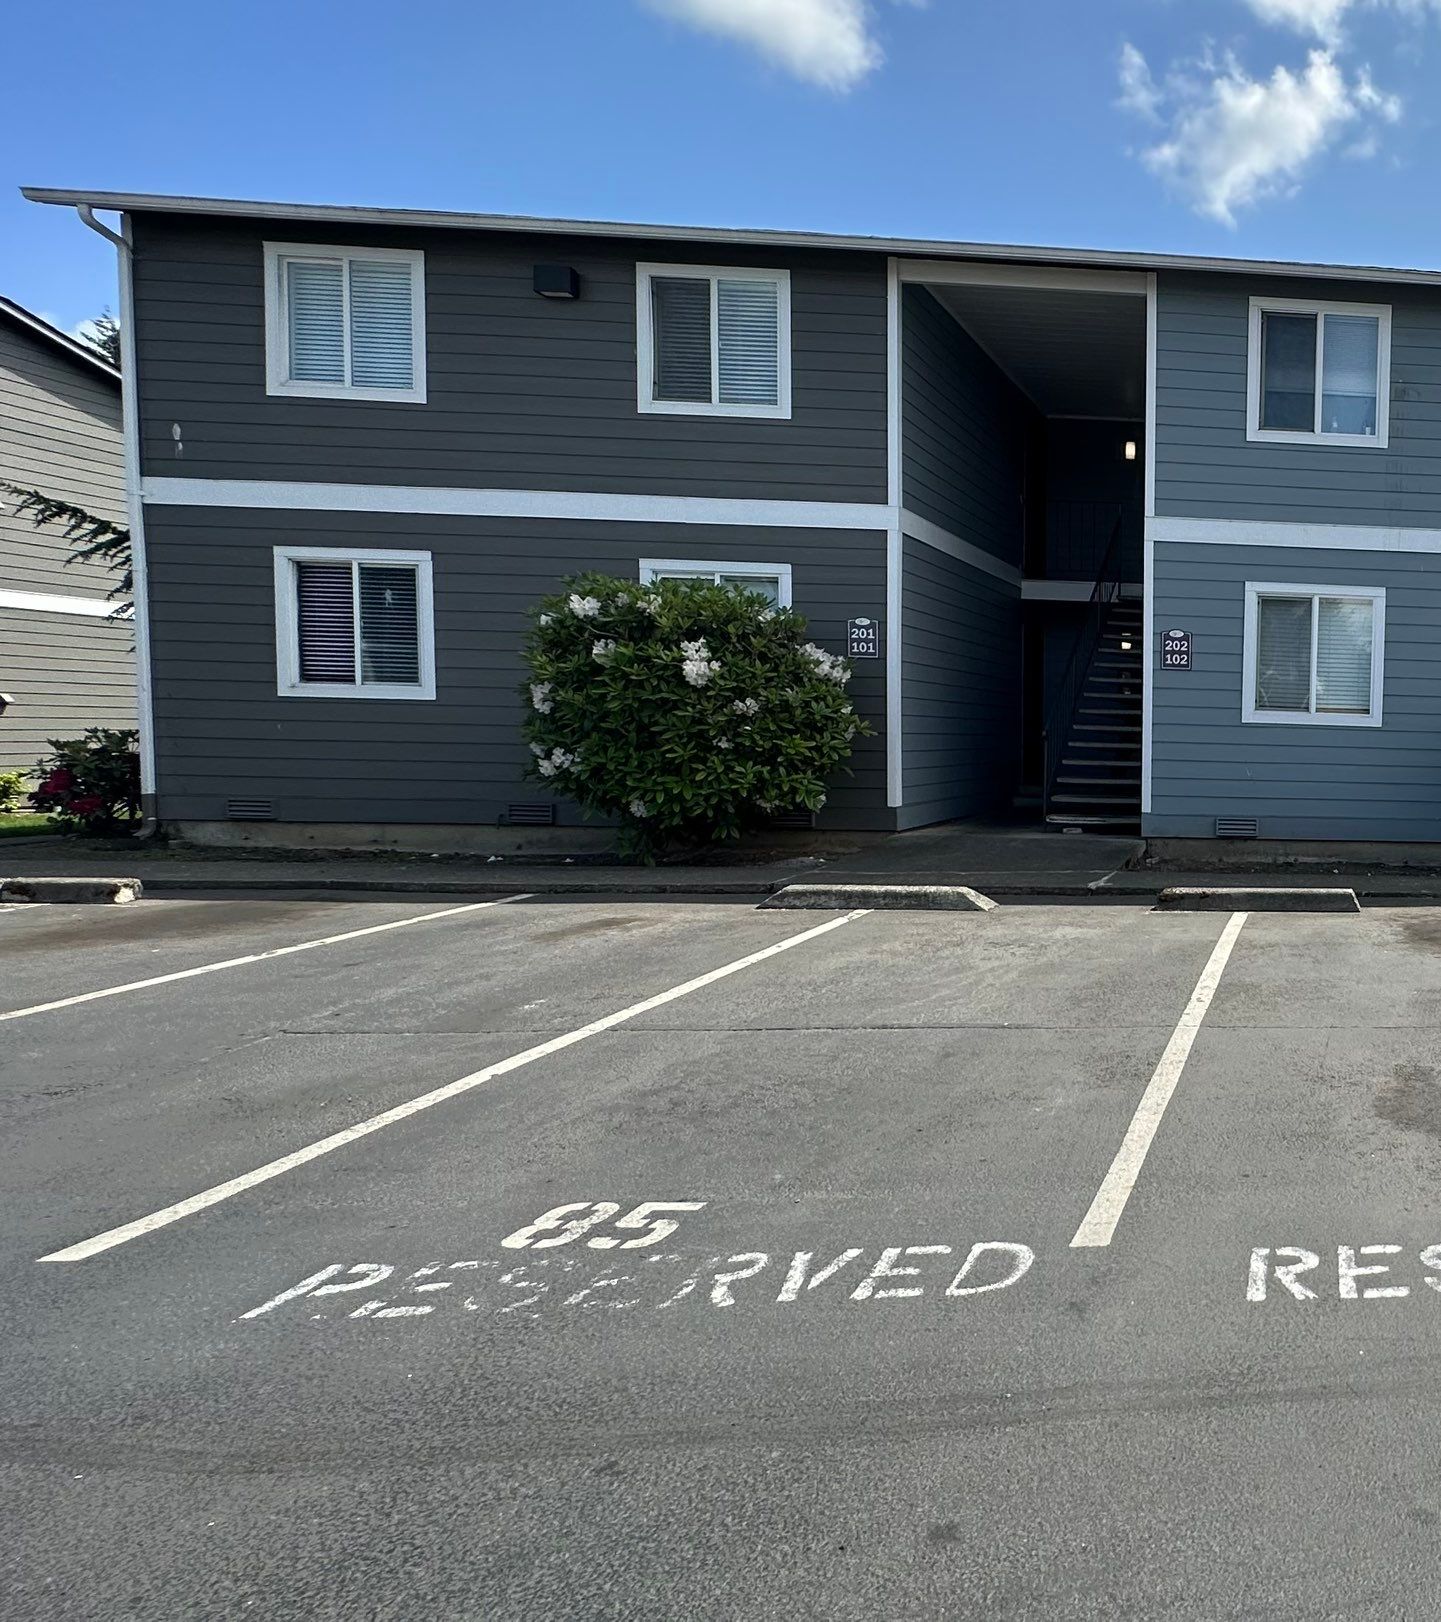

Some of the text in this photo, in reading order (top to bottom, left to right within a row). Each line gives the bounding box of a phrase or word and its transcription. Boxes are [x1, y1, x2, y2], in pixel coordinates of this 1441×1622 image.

[851, 628, 875, 639] 201
[851, 641, 876, 653] 101
[1165, 640, 1188, 651] 202
[1165, 653, 1188, 664] 102
[501, 1201, 708, 1249] 85
